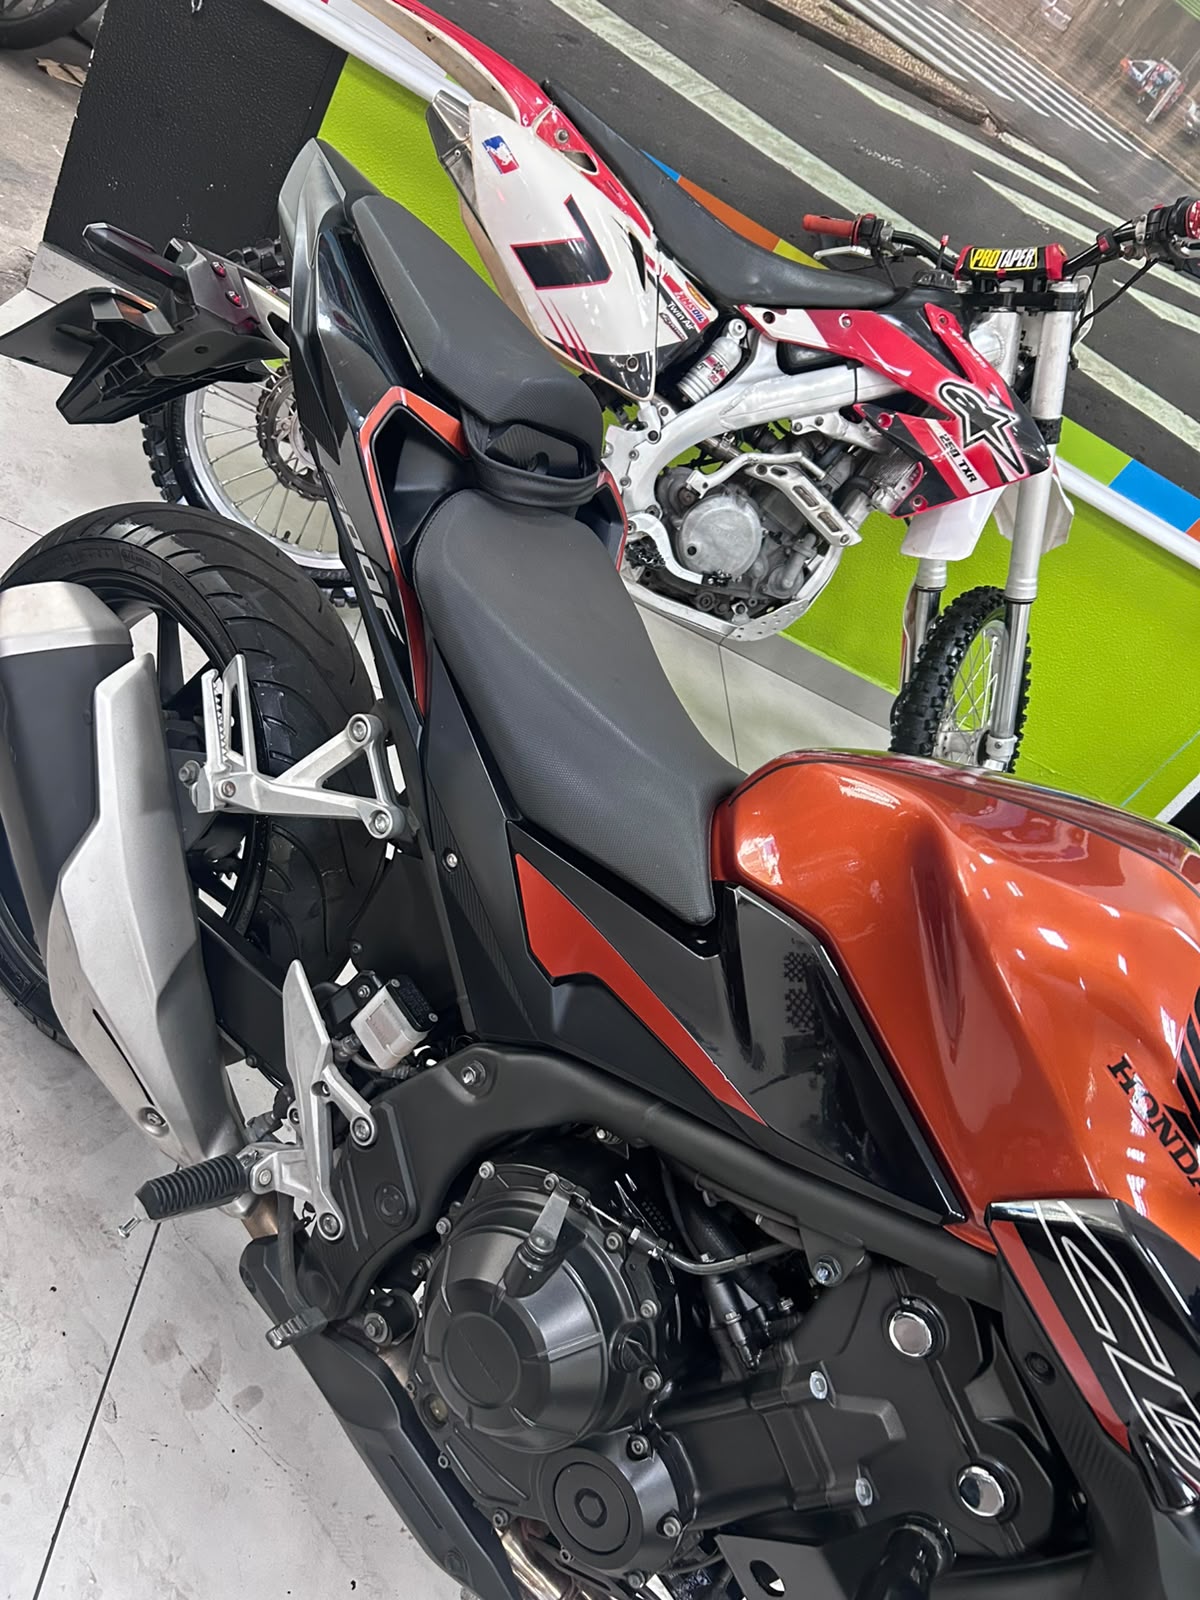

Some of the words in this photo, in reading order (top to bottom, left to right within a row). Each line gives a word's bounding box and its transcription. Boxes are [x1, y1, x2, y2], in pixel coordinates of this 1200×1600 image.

[973, 248, 1034, 269] PROTAPER
[667, 301, 685, 321] Twin
[682, 318, 696, 330] Air
[674, 287, 705, 322] AMSOIL
[939, 433, 959, 458] 250
[958, 458, 977, 483] TXR
[1107, 1055, 1200, 1197] HOND
